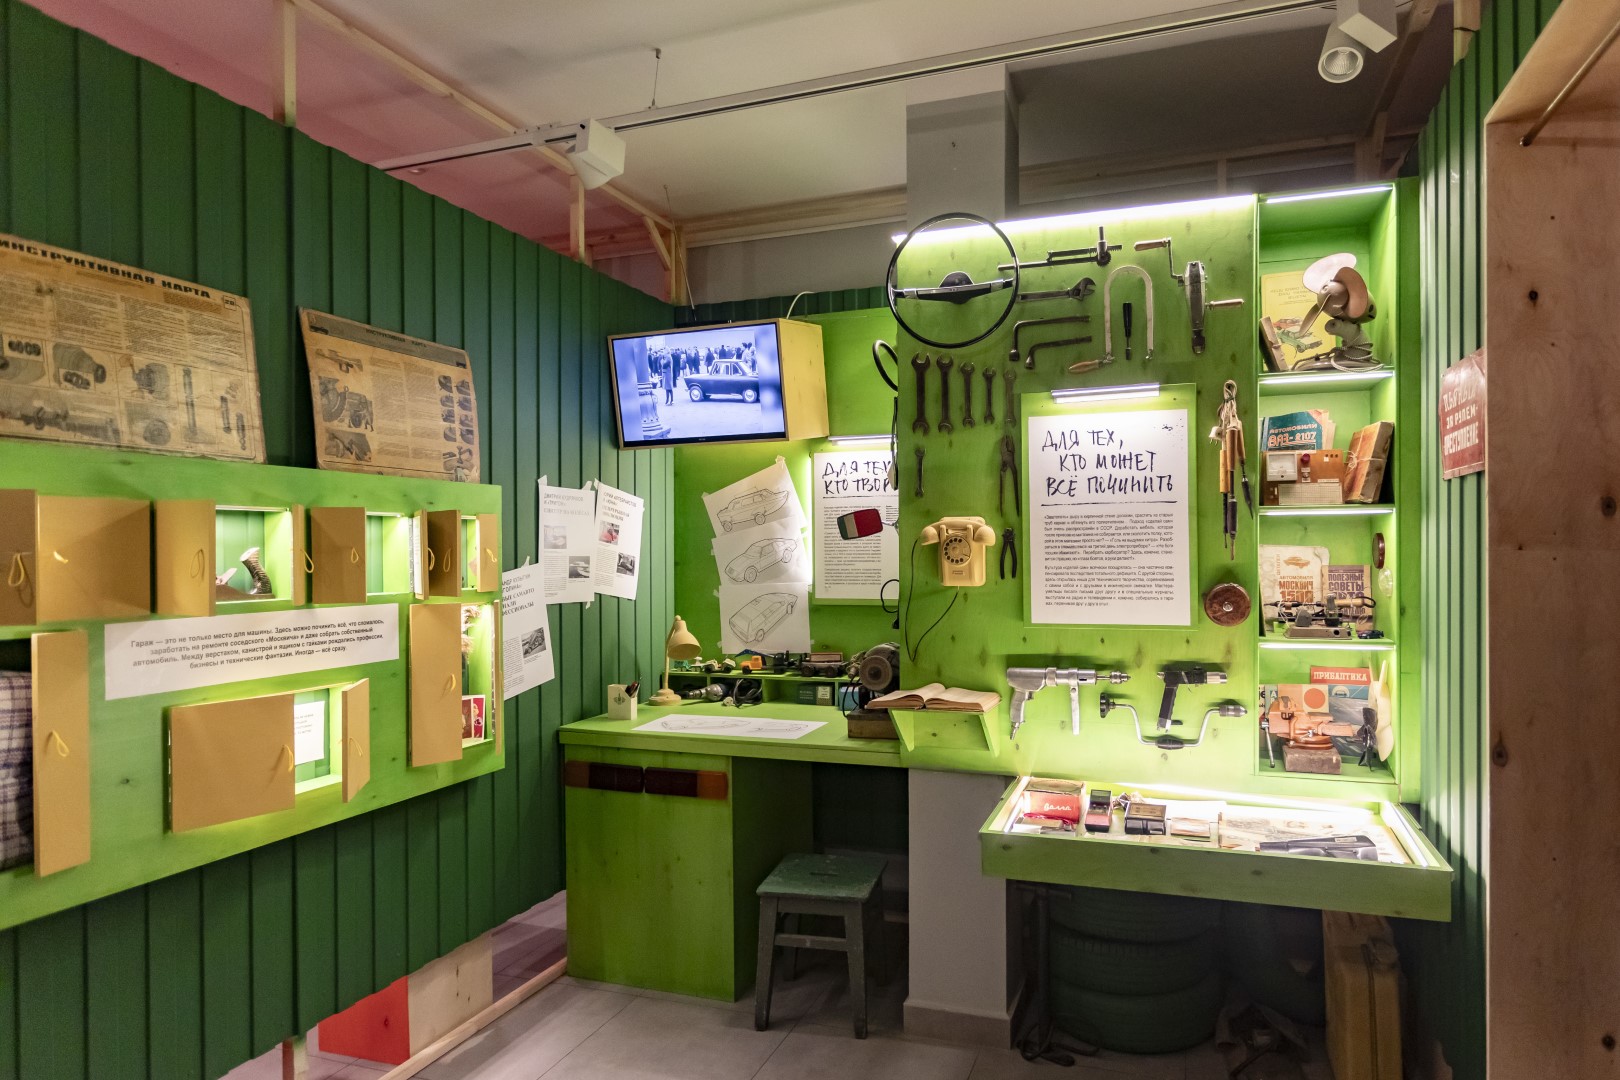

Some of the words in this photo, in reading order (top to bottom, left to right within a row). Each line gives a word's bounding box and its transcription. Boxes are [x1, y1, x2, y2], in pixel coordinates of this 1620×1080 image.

[1269, 423, 1317, 433] АВТОМОБИЛИ
[1042, 429, 1079, 451] ДЛЯ
[1087, 429, 1124, 449] ТЕХ,
[822, 460, 858, 479] ДЛЯ
[1059, 454, 1087, 472] КТО
[1095, 450, 1156, 472] МОЖЕТ
[824, 479, 848, 494] КТО
[1046, 475, 1078, 497] ВСЁ
[1087, 474, 1173, 495] ПОЧИНИТЬ
[1279, 581, 1313, 590] МОСКВИЧ
[1329, 582, 1364, 591] СОВЕТЫ
[150, 646, 190, 655] заработать
[202, 641, 228, 650] ремонте
[230, 638, 264, 646] соседского
[341, 627, 373, 635] собственный
[133, 656, 179, 667] автомобиль.
[206, 649, 240, 658] верстаком,
[242, 645, 272, 654] канистрой
[190, 661, 219, 669] бизнесы
[226, 656, 263, 664] технические
[1313, 672, 1367, 681] ПРИБАЛТИКА
